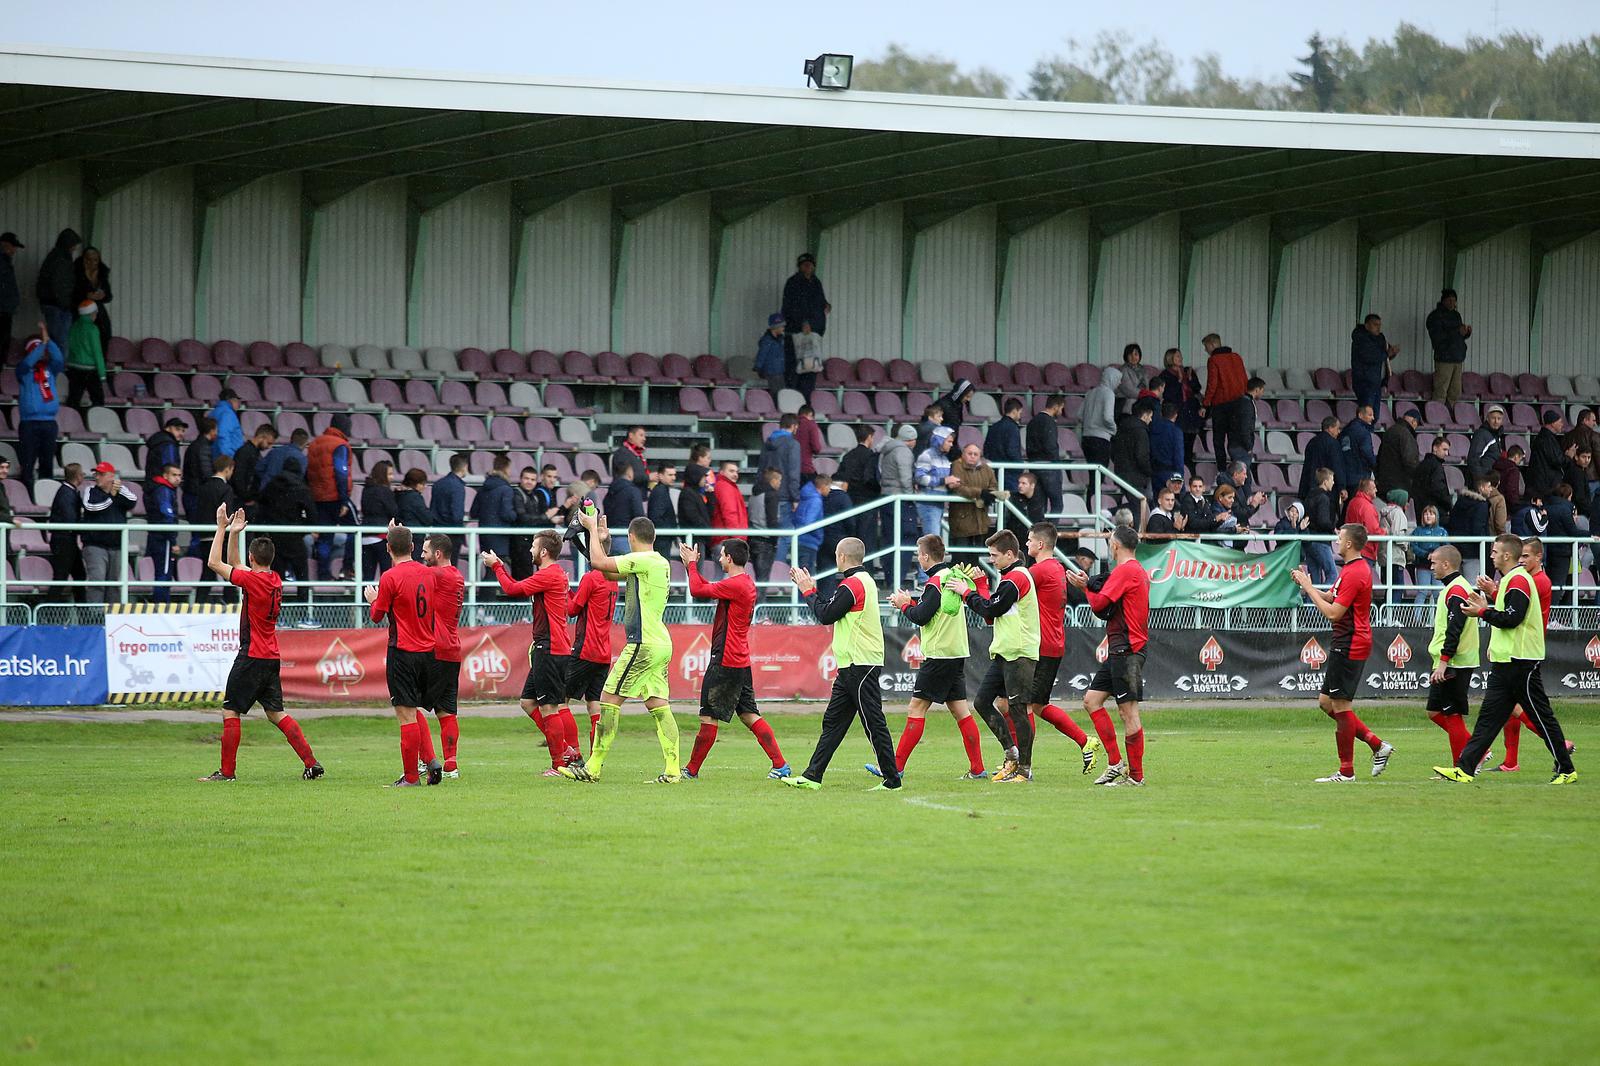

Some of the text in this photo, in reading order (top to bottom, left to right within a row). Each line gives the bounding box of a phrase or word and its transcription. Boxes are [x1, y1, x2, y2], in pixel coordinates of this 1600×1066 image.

[1151, 549, 1267, 583] Jamnica
[416, 583, 427, 618] 6
[211, 629, 239, 641] HHH
[119, 641, 184, 656] trgomont
[221, 643, 240, 652] GRA
[1201, 645, 1222, 662] pik
[1303, 643, 1325, 663] pik
[1390, 644, 1409, 662] pik
[0, 655, 90, 676] atska.hr
[321, 653, 359, 684] pik
[467, 650, 506, 682] pik
